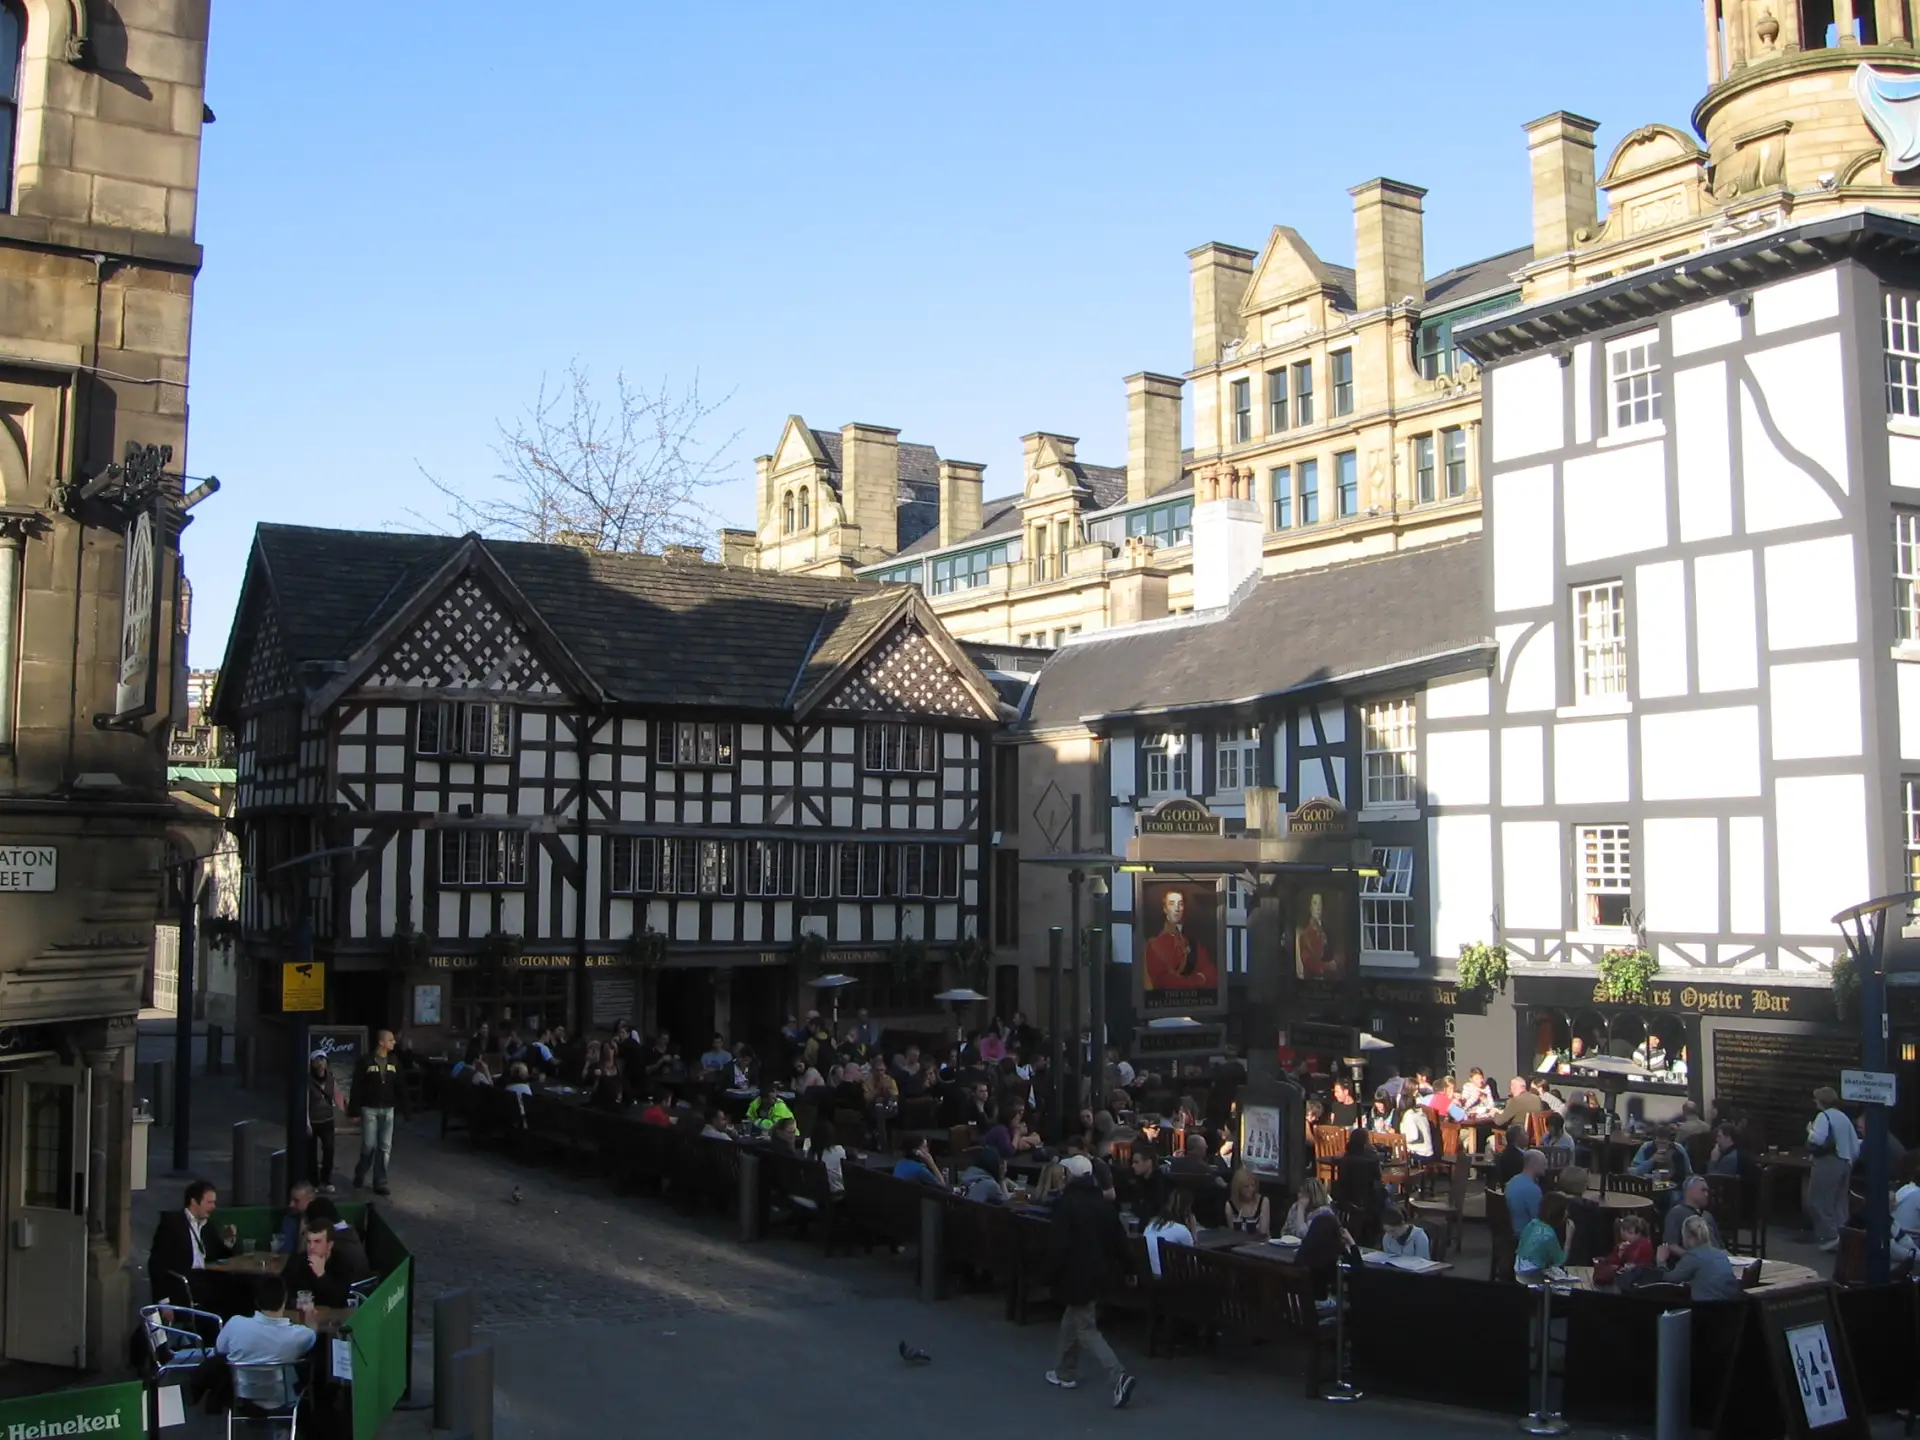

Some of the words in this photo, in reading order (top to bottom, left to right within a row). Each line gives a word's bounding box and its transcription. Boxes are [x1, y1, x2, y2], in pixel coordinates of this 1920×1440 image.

[1161, 808, 1200, 822] GOOD
[1302, 808, 1334, 822] GOOD
[1146, 822, 1174, 831] FOOD
[1176, 823, 1196, 832] ALL
[1197, 823, 1216, 832] DAY
[1292, 823, 1313, 832] FOOD
[428, 955, 450, 968] THE
[452, 956, 477, 968] OLD
[551, 955, 570, 967] INN
[585, 955, 594, 967] &
[759, 952, 776, 963] THE
[1680, 986, 1743, 1013] Oyster
[1751, 988, 1791, 1013] Bar
[1844, 1078, 1892, 1089] skateboarding
[8, 1413, 122, 1440] Heineken
